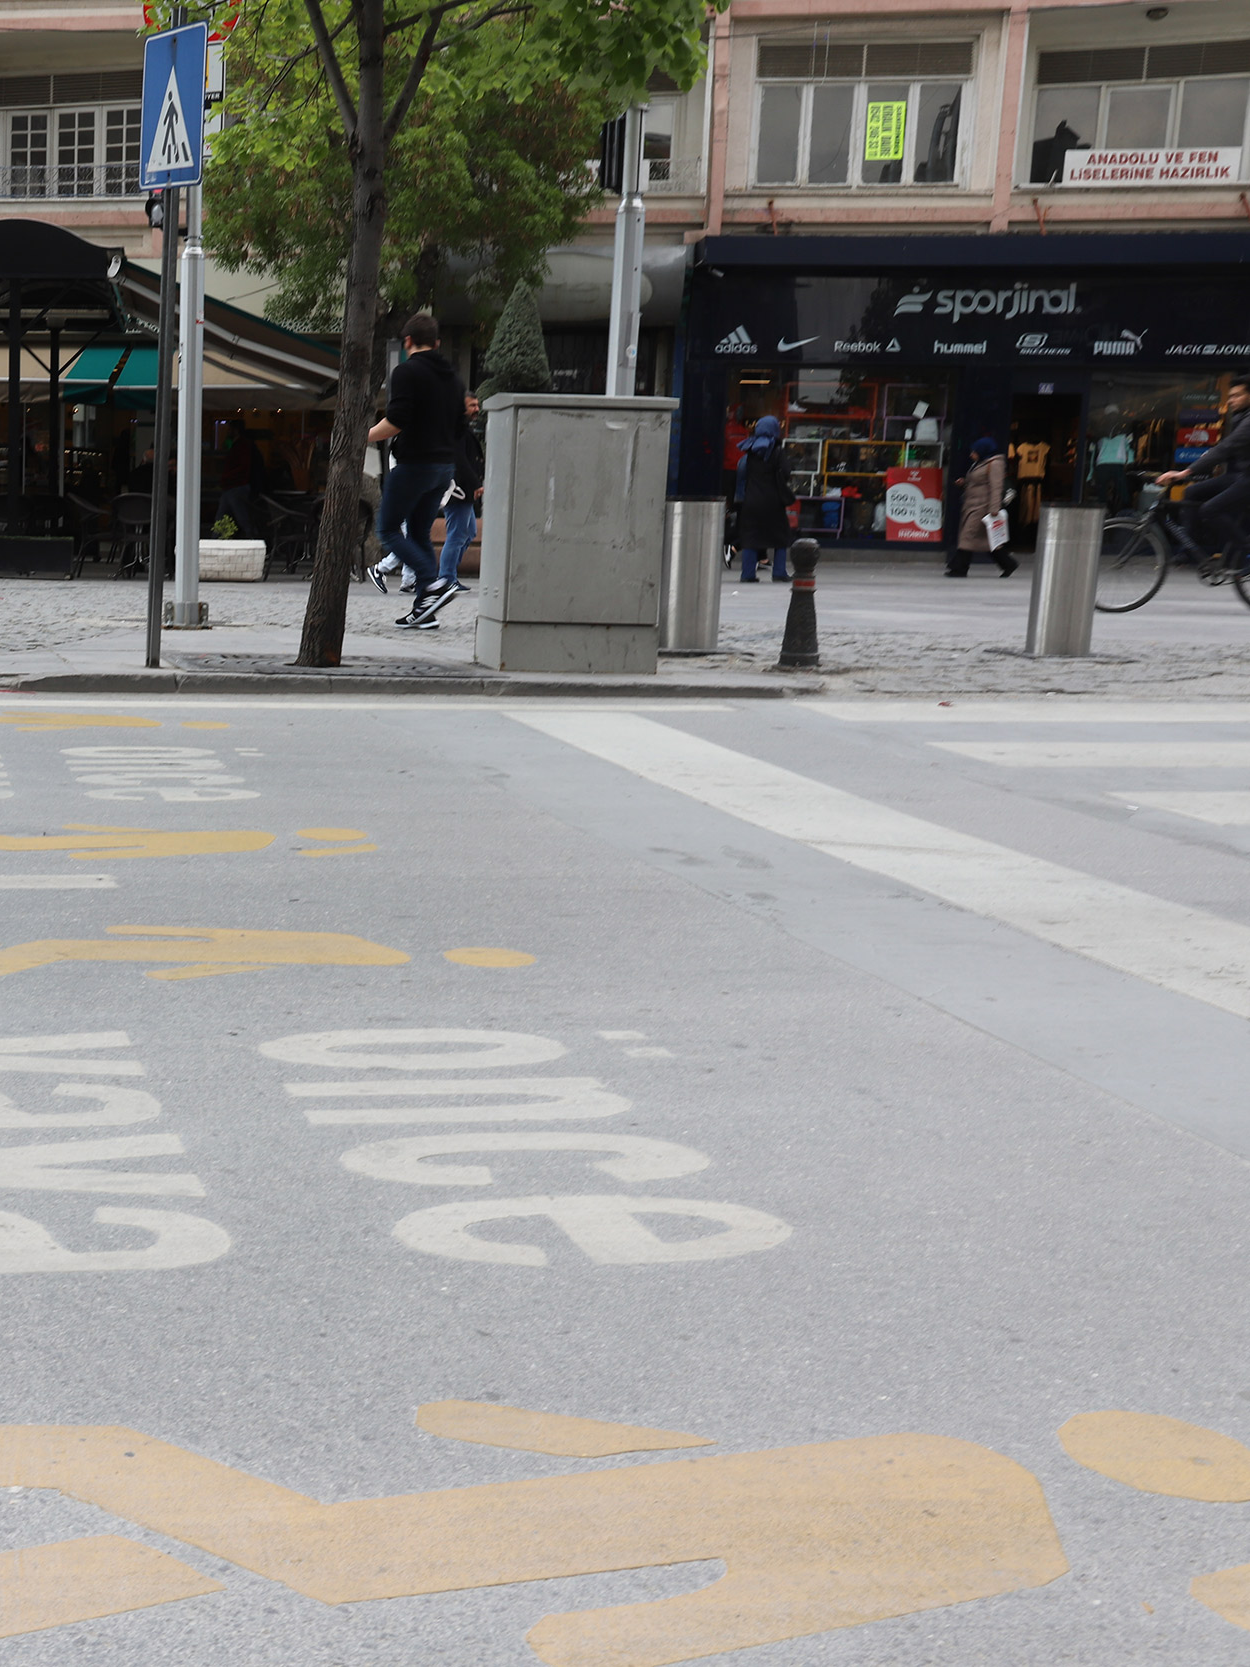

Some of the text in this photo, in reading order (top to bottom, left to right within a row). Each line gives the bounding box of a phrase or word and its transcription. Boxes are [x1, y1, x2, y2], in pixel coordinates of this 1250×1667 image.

[1086, 151, 1219, 165] ANADOLU VE FEN
[1069, 166, 1231, 181] LİSELERİNE HAZIRLIK
[933, 282, 1078, 323] sporjinal
[715, 341, 758, 354] adidas
[834, 340, 881, 353] Reebok
[933, 340, 987, 354] hummel
[1093, 341, 1135, 355] PUMA
[1165, 344, 1202, 356] JACK
[59, 745, 265, 802] önce
[258, 1028, 794, 1268] önce
